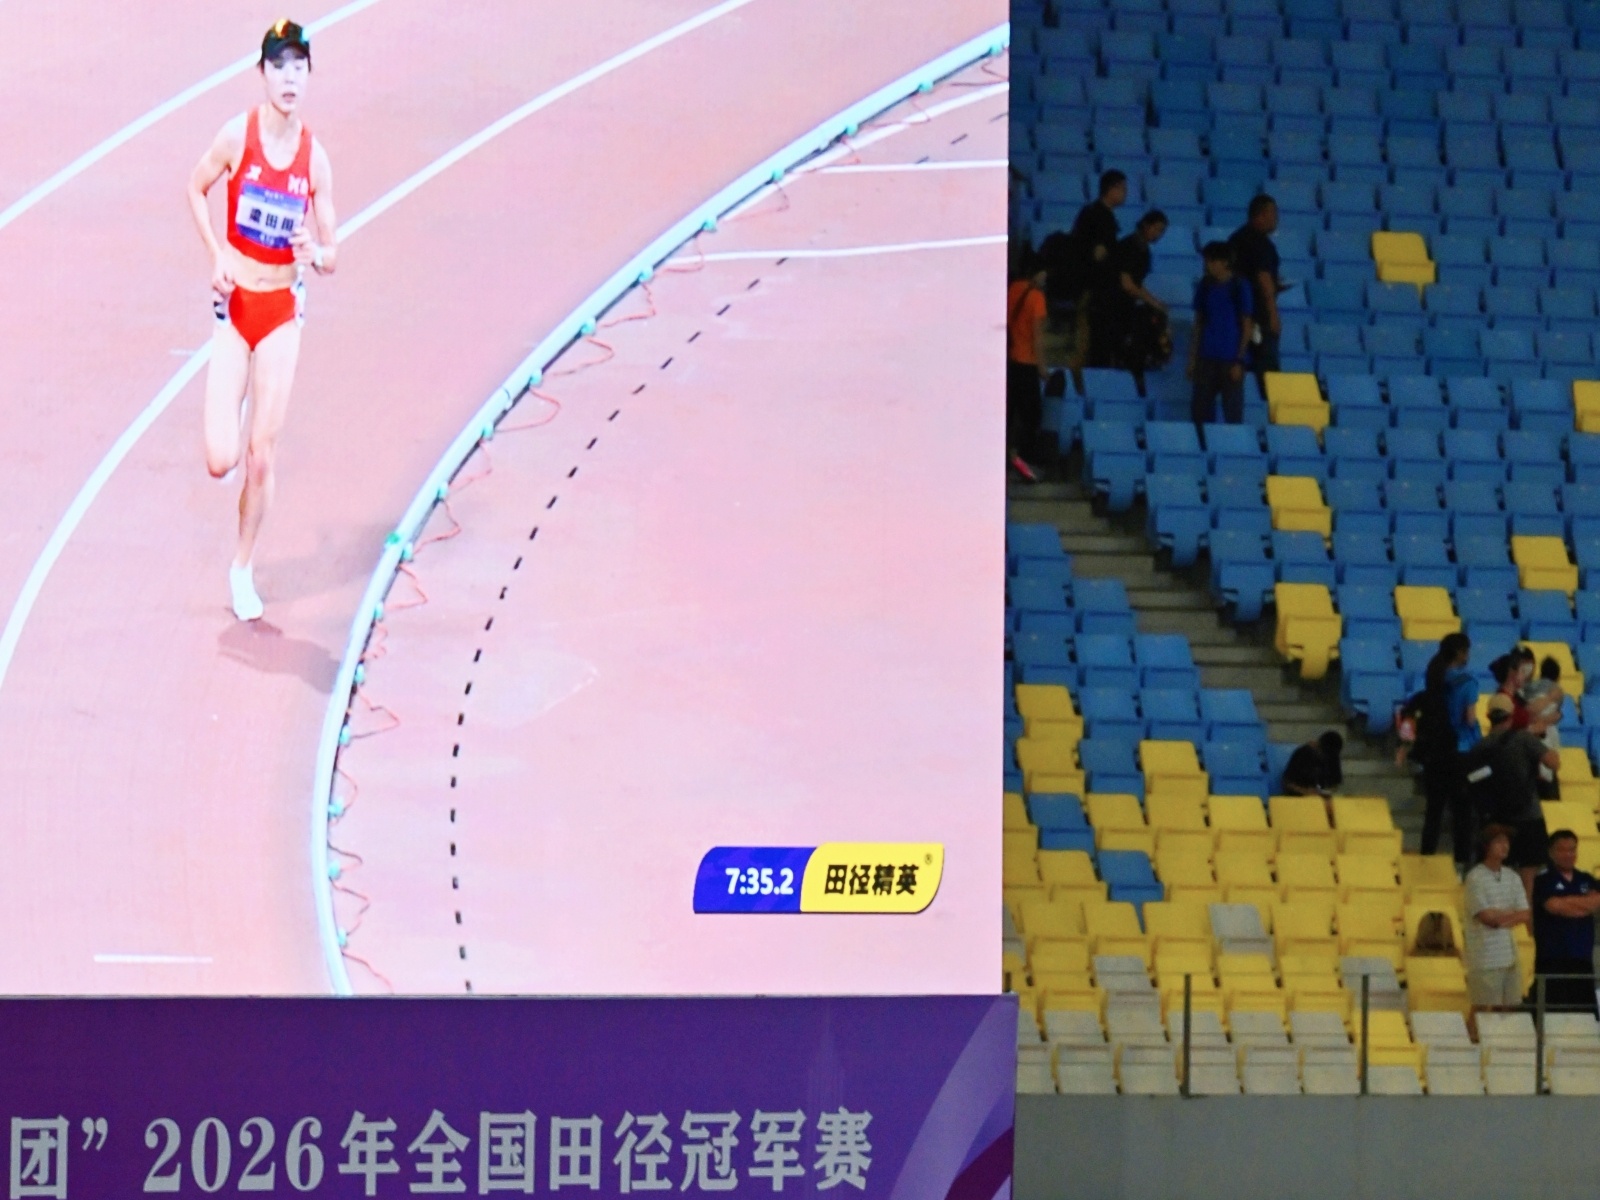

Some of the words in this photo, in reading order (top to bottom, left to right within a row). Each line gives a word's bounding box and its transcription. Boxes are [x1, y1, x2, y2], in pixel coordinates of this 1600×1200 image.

[725, 867, 794, 895] 7:35.2
[824, 864, 919, 895] 田径精英
[143, 1107, 873, 1196] 2026年全国田径冠军赛
